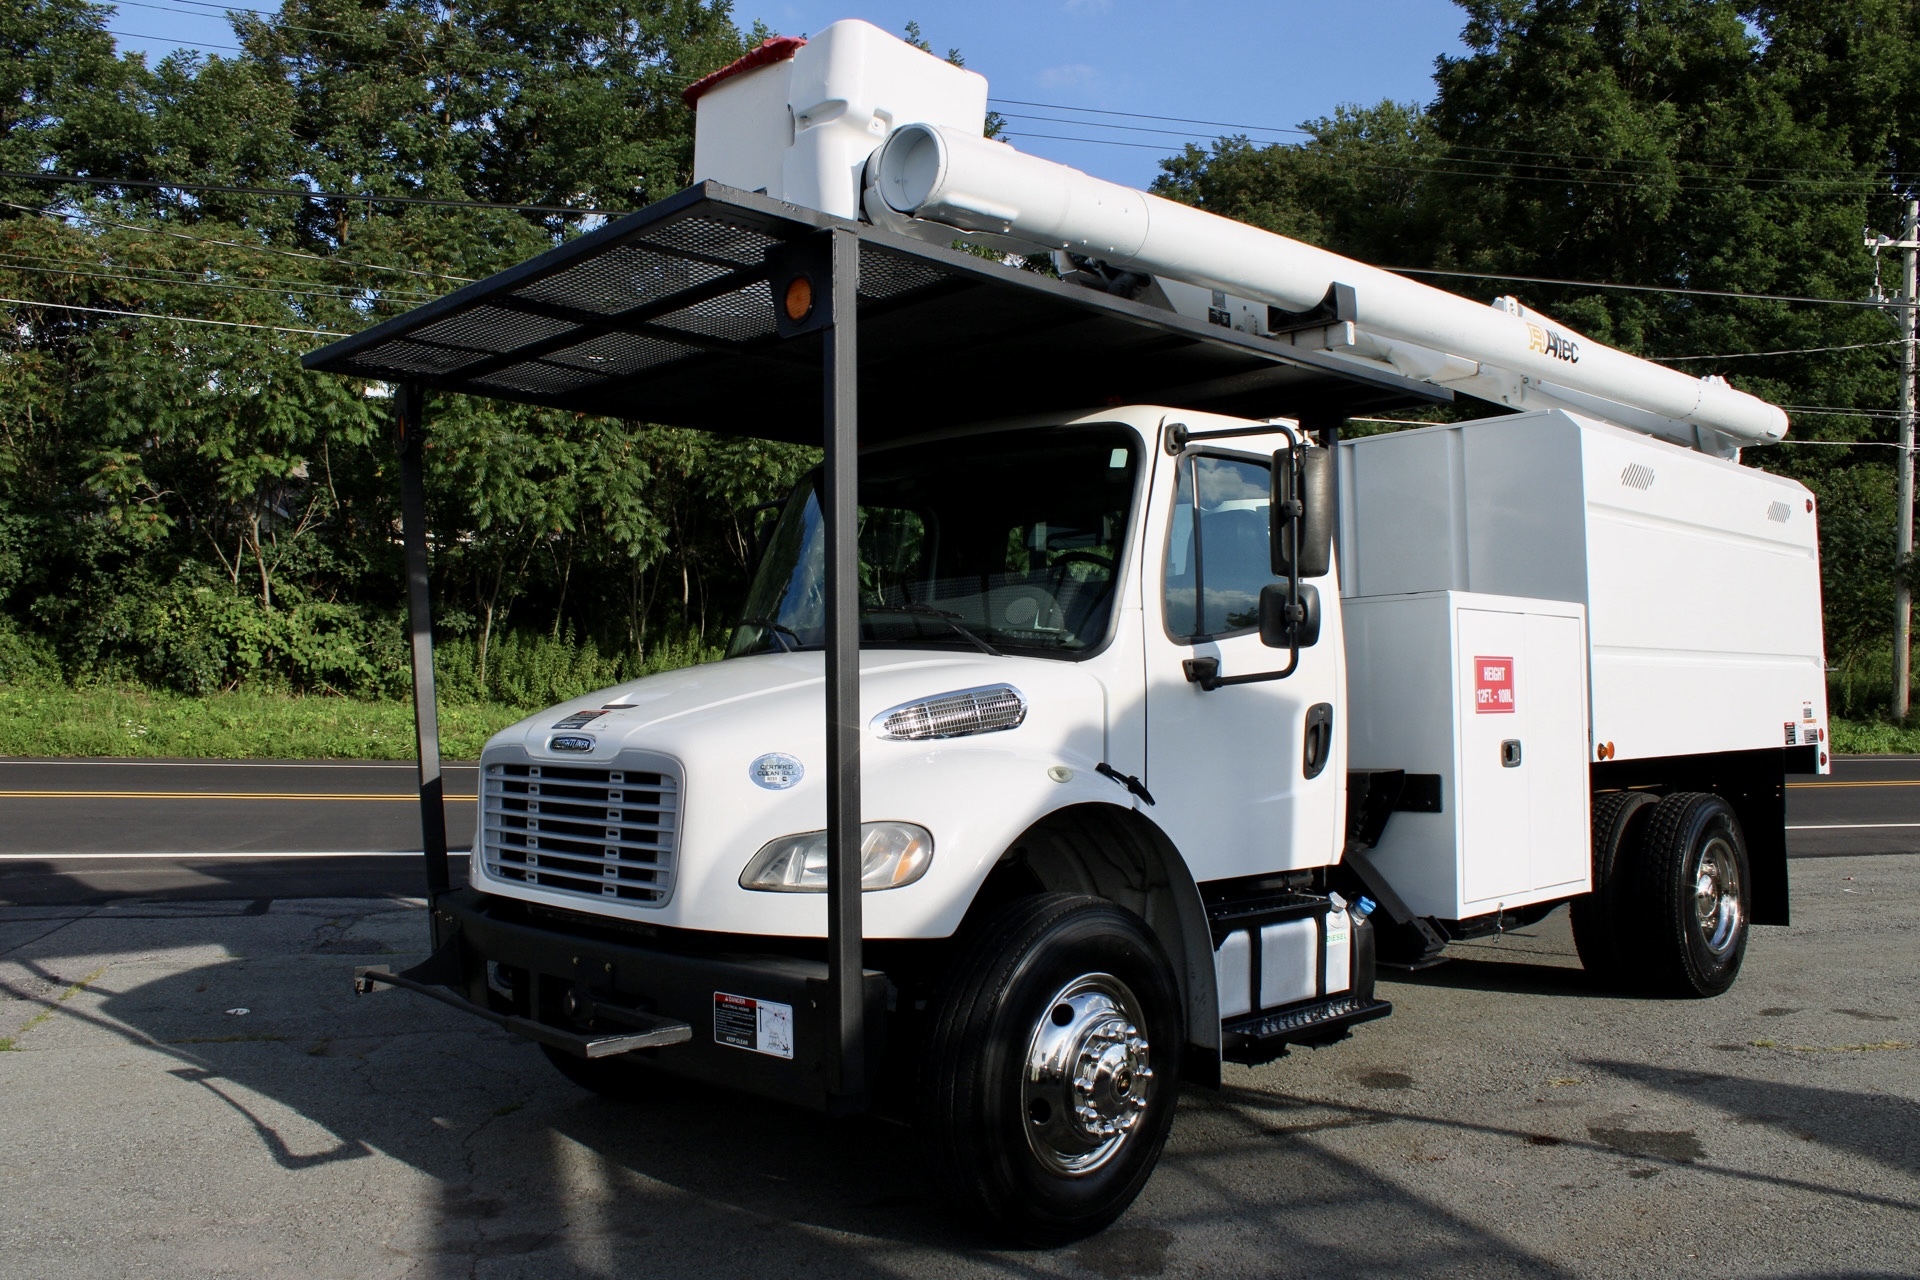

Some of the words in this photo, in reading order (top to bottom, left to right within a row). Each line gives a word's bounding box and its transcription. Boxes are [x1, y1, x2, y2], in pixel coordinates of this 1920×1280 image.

[1484, 667, 1505, 681] HEIGHT
[1326, 932, 1347, 943] DIESEL
[729, 997, 746, 1005] DANGER
[736, 1038, 749, 1046] CLEAR
